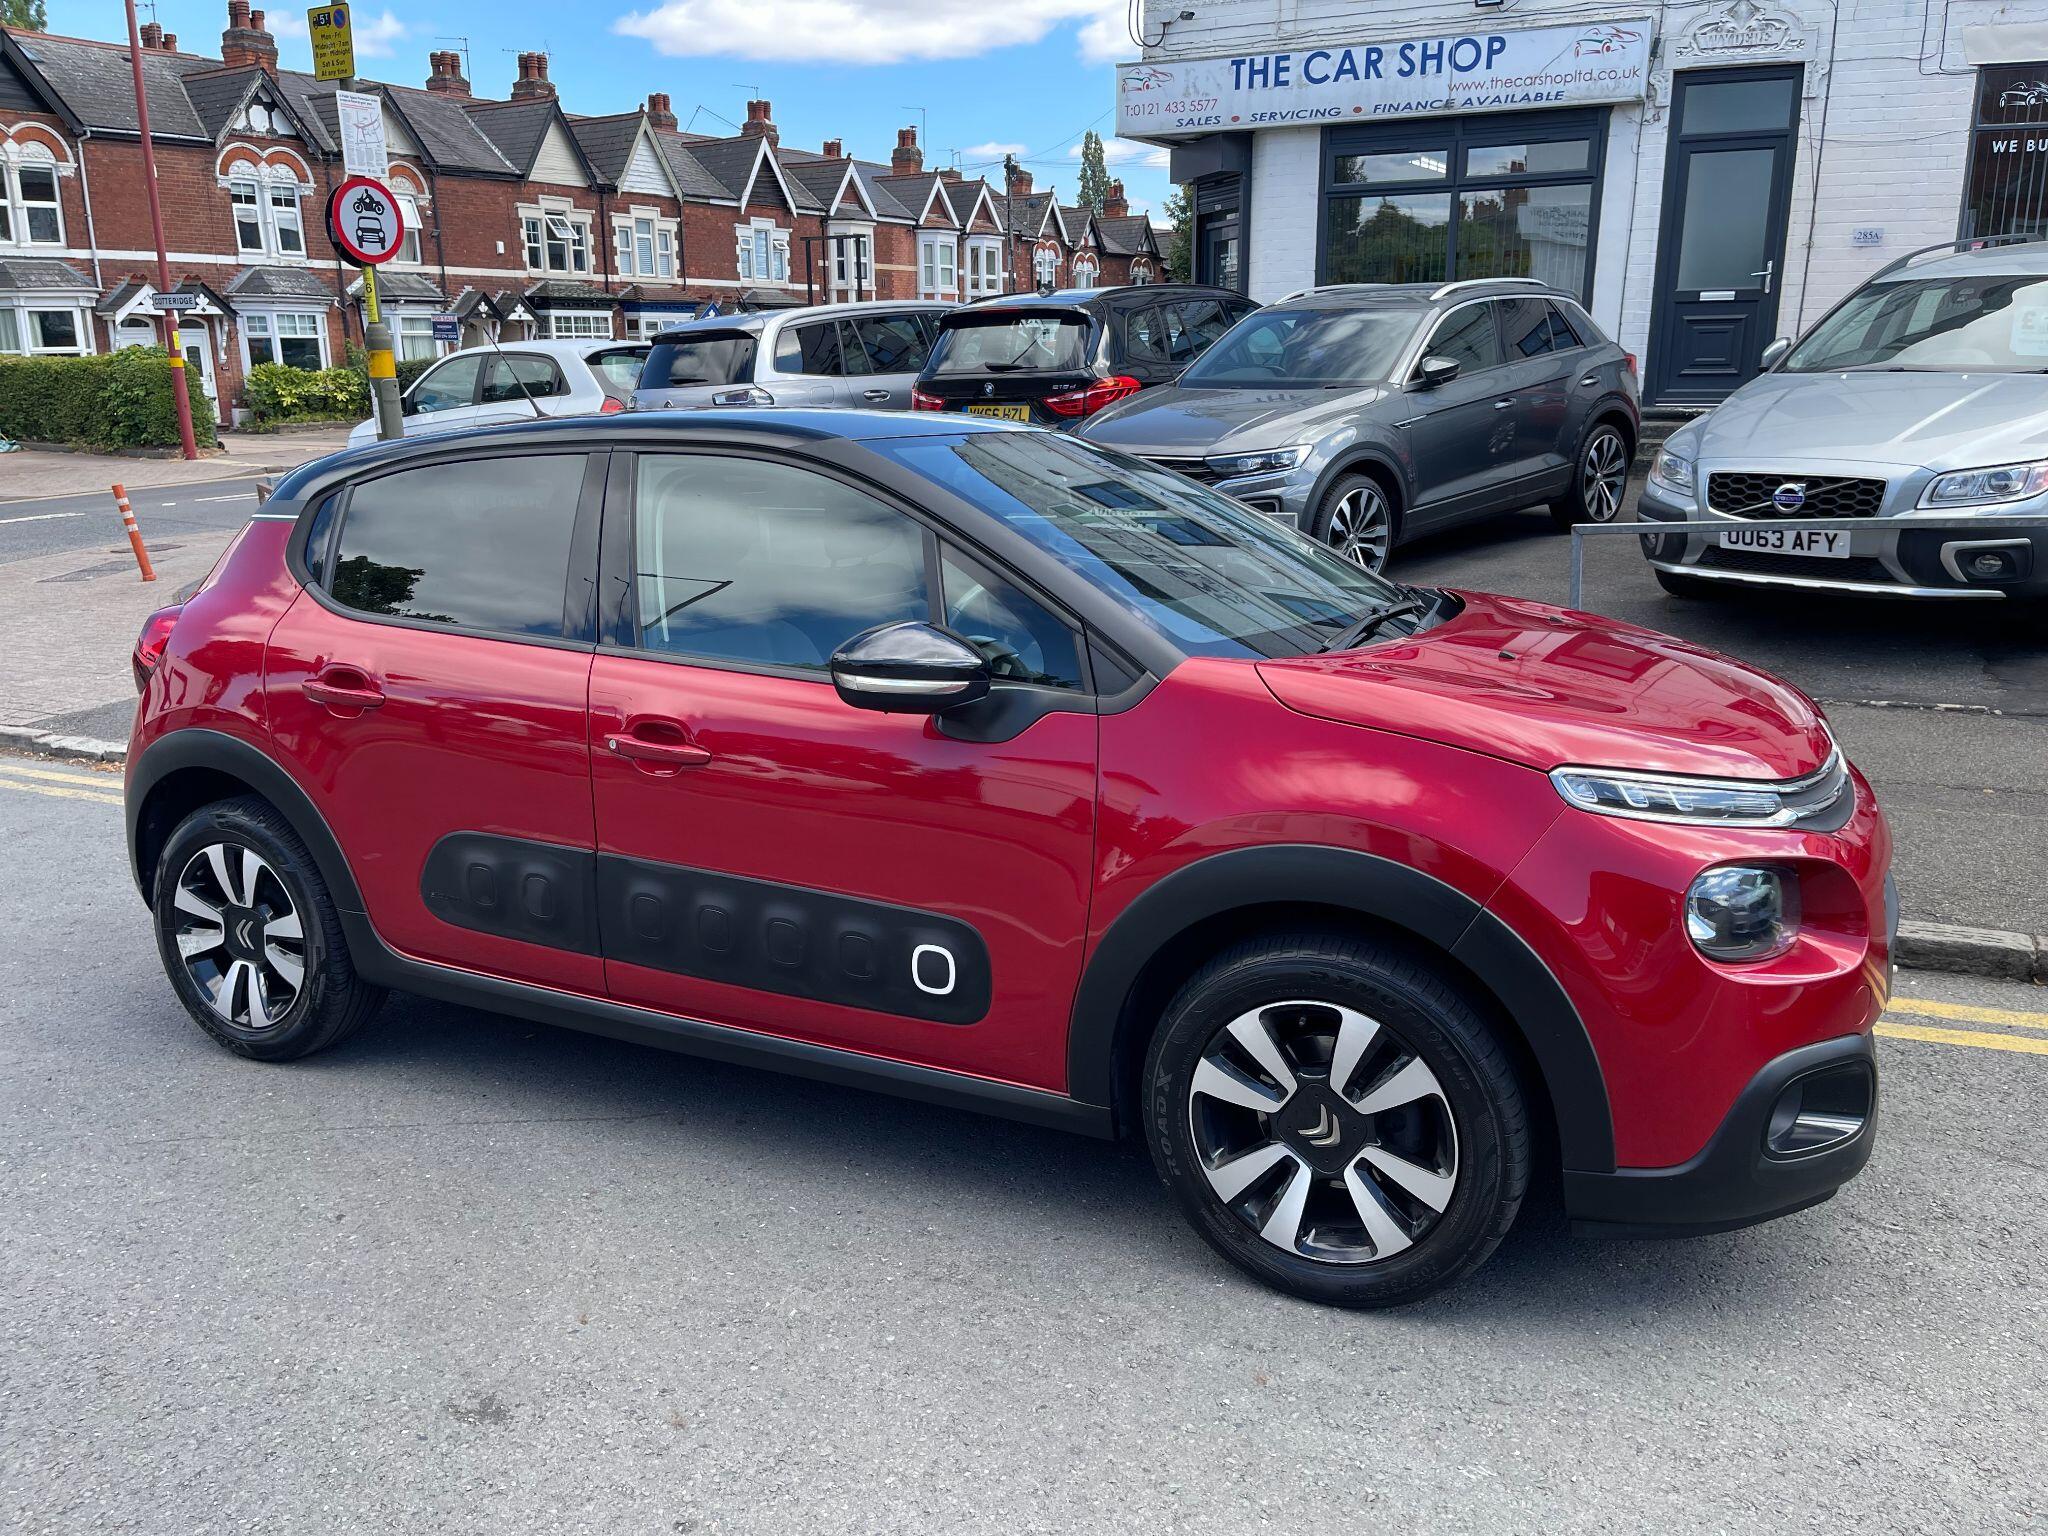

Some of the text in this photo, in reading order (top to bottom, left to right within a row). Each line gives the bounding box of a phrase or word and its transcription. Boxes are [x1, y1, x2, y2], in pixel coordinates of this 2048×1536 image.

[1231, 36, 1507, 90] THE CAR SHOP
[1448, 65, 1641, 92] www.thecarshopltd.co.uk
[1164, 100, 1185, 114] 433
[1189, 98, 1218, 112] 5577
[1176, 90, 1565, 128] SALES SERVICING FINANCE AVAILABLE
[1992, 140, 2018, 153] WE
[1856, 231, 1880, 240] 285A
[154, 297, 193, 305] COTTERIDGE
[1791, 530, 1838, 553] AFY
